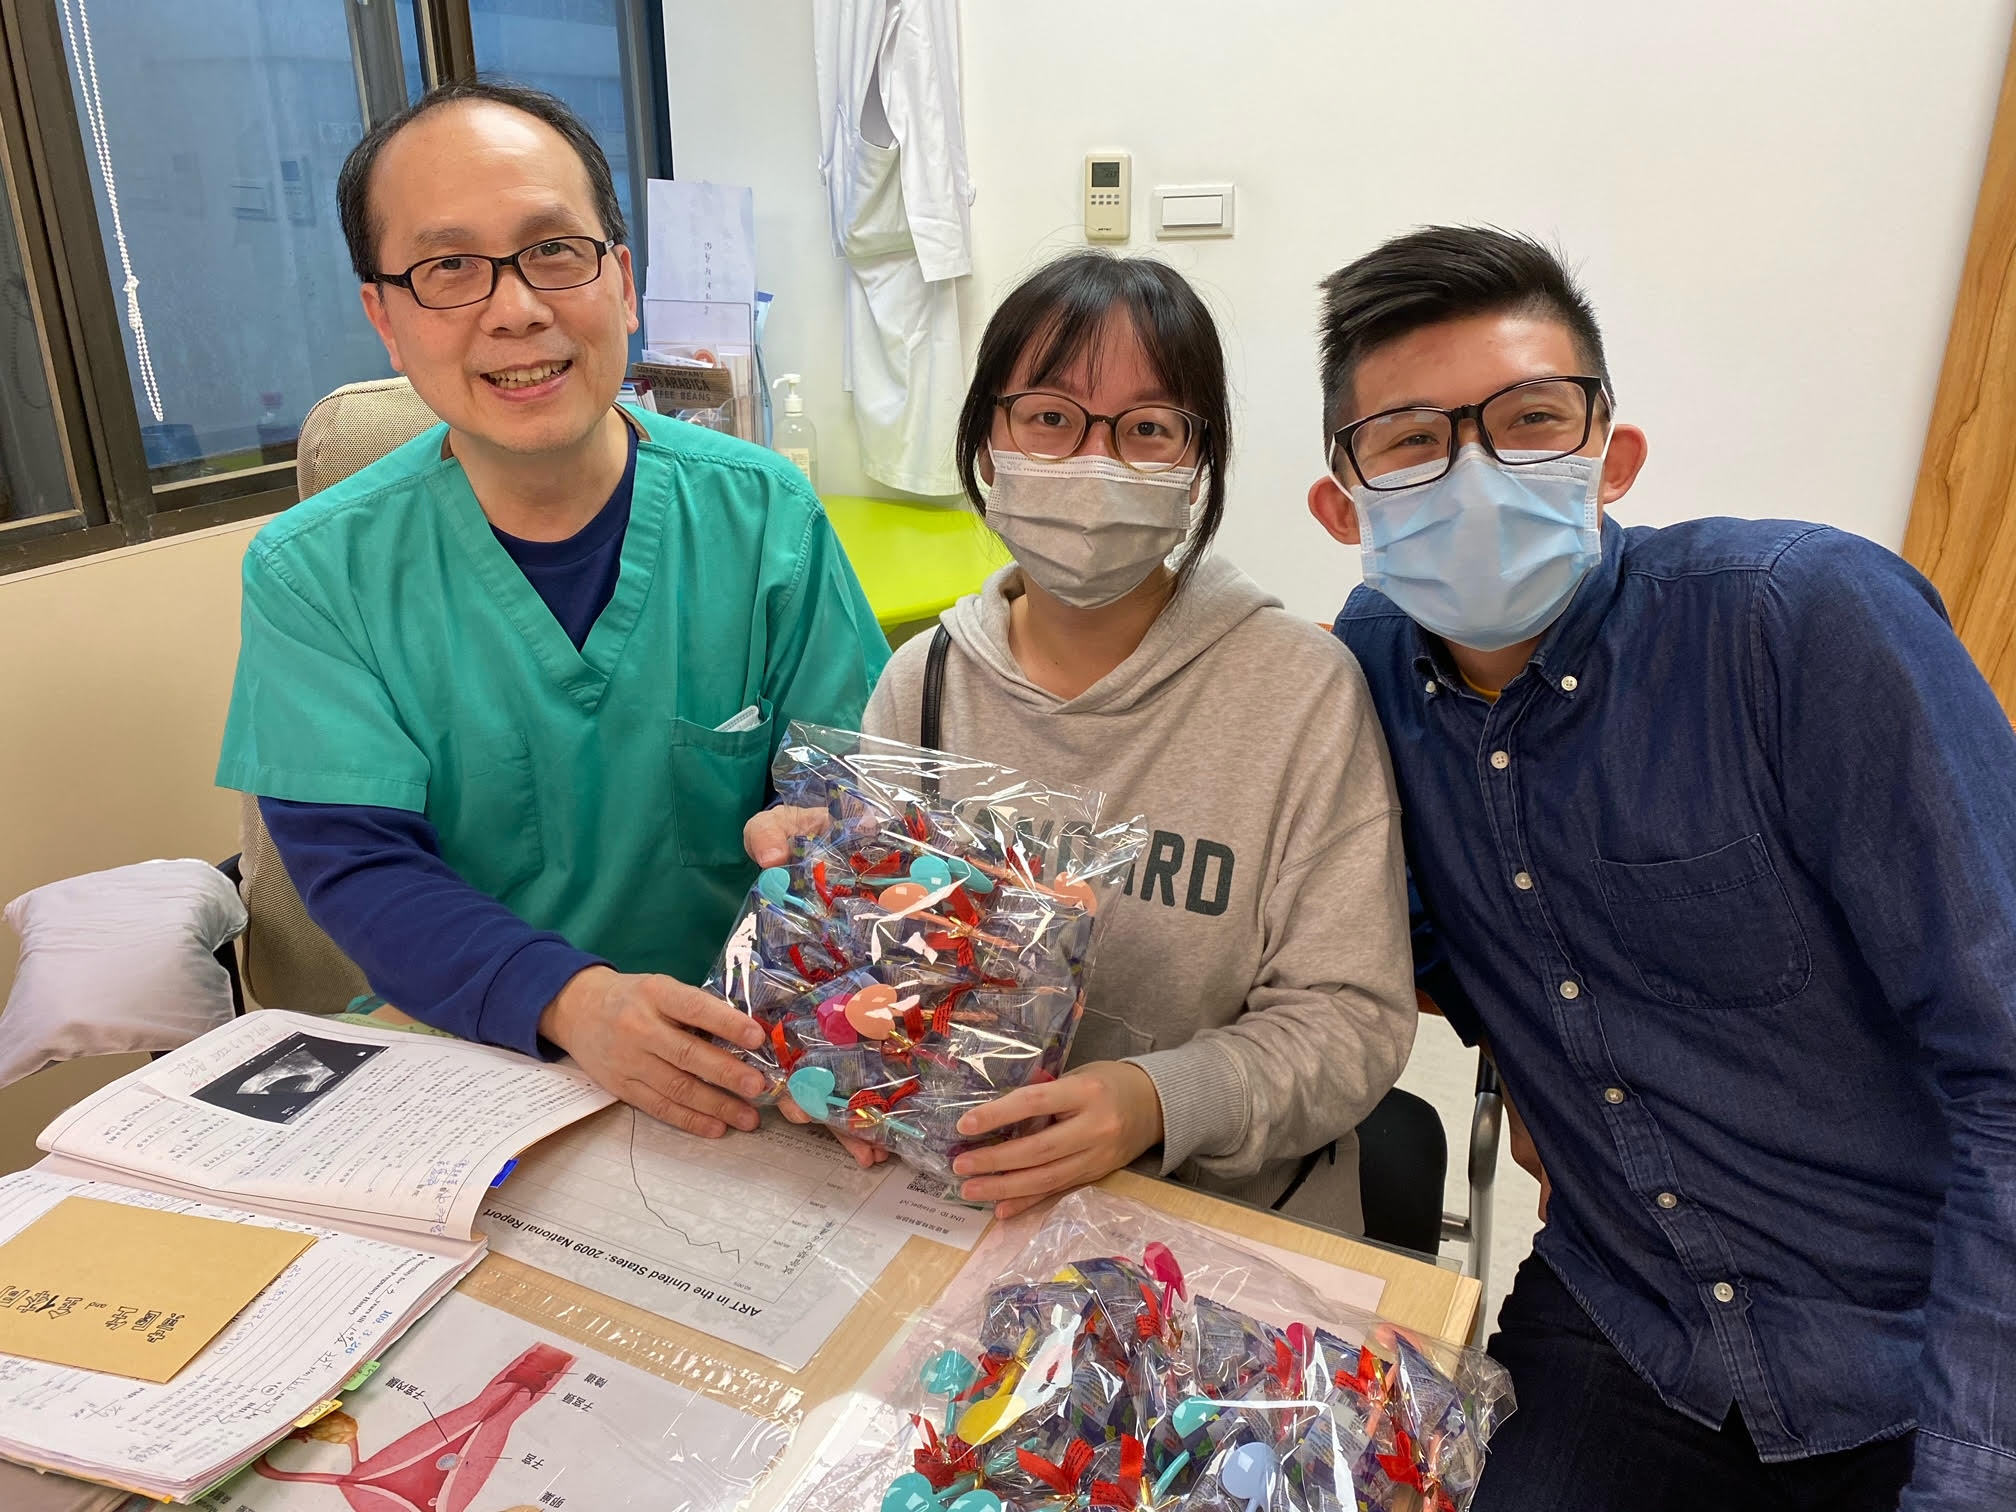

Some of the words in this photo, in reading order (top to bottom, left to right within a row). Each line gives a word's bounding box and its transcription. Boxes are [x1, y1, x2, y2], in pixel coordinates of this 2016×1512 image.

[665, 369, 704, 378] COMPANY
[663, 376, 711, 392] ARABICA
[679, 391, 711, 401] BEANS
[482, 1208, 525, 1229] Report
[522, 1224, 574, 1248] National
[573, 1243, 604, 1259] 2009
[604, 1253, 649, 1276] States:
[647, 1270, 692, 1292] United
[693, 1286, 715, 1300] the
[716, 1294, 731, 1307] in
[84, 1301, 108, 1310] and
[348, 1296, 371, 1316] History
[728, 1301, 763, 1317] ART
[521, 1452, 545, 1470] 子宮
[538, 1490, 566, 1509] 卵巢
